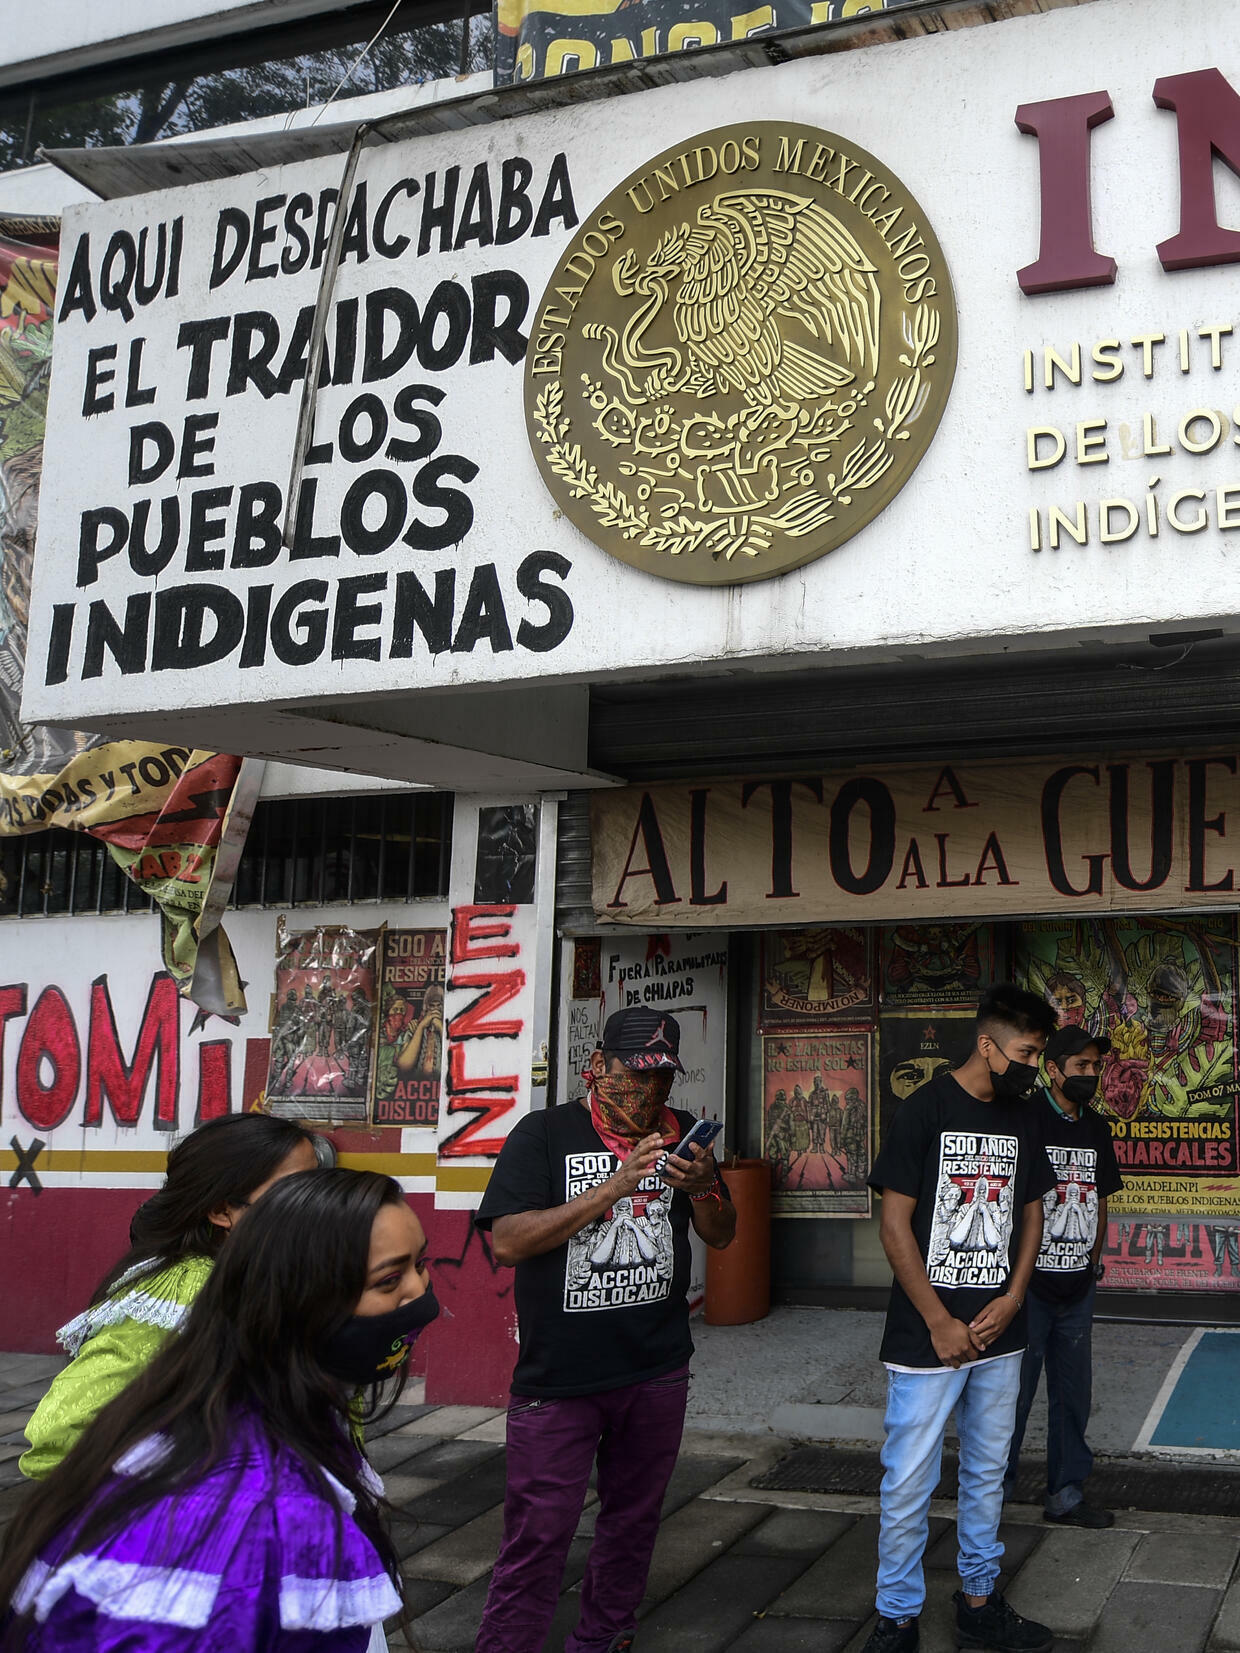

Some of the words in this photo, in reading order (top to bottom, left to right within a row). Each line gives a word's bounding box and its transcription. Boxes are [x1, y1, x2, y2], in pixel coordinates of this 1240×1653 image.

[626, 136, 760, 214] UNIDOS
[773, 136, 936, 304] MEXICANOS
[58, 215, 183, 323] AQUI
[209, 152, 580, 294] DESPACHABA
[531, 210, 626, 377] ESTADOS
[82, 337, 157, 418] EL
[177, 270, 531, 402] TRAIDOR
[128, 411, 219, 488] DE
[304, 382, 447, 466] LOS
[1026, 418, 1110, 471] DE
[77, 454, 480, 590] PUEBLOS
[45, 550, 573, 687] INDIGENAS
[119, 747, 193, 796] TOD
[606, 776, 896, 909] ALTO
[387, 934, 426, 958] 500
[385, 965, 446, 982] RESISTE
[609, 953, 651, 983] FUERA
[626, 990, 641, 1007] DE
[643, 977, 694, 1002] CHIAPAS
[795, 1040, 865, 1057] ZAPATISTAS
[394, 1080, 440, 1100] ACCI
[1189, 1090, 1212, 1102] DOM
[1212, 1085, 1224, 1097] 07
[378, 1101, 439, 1121] DISLOC
[1131, 1121, 1232, 1139] RESISTENCIAS
[944, 1135, 977, 1155] 500
[980, 1136, 1016, 1157] AÑOS
[1113, 1141, 1233, 1167] RIARCALES
[570, 1155, 612, 1176] 500
[942, 1160, 1014, 1175] RESISTENCIA
[1113, 1195, 1125, 1204] DE
[1127, 1195, 1145, 1204] LOS
[1147, 1195, 1190, 1205] PUEBLOS
[945, 1250, 999, 1268] ACCIÓN
[588, 1264, 659, 1291] ACCIÓN
[929, 1266, 1006, 1285] DISLOCADA
[569, 1281, 667, 1309] DISLOCADA
